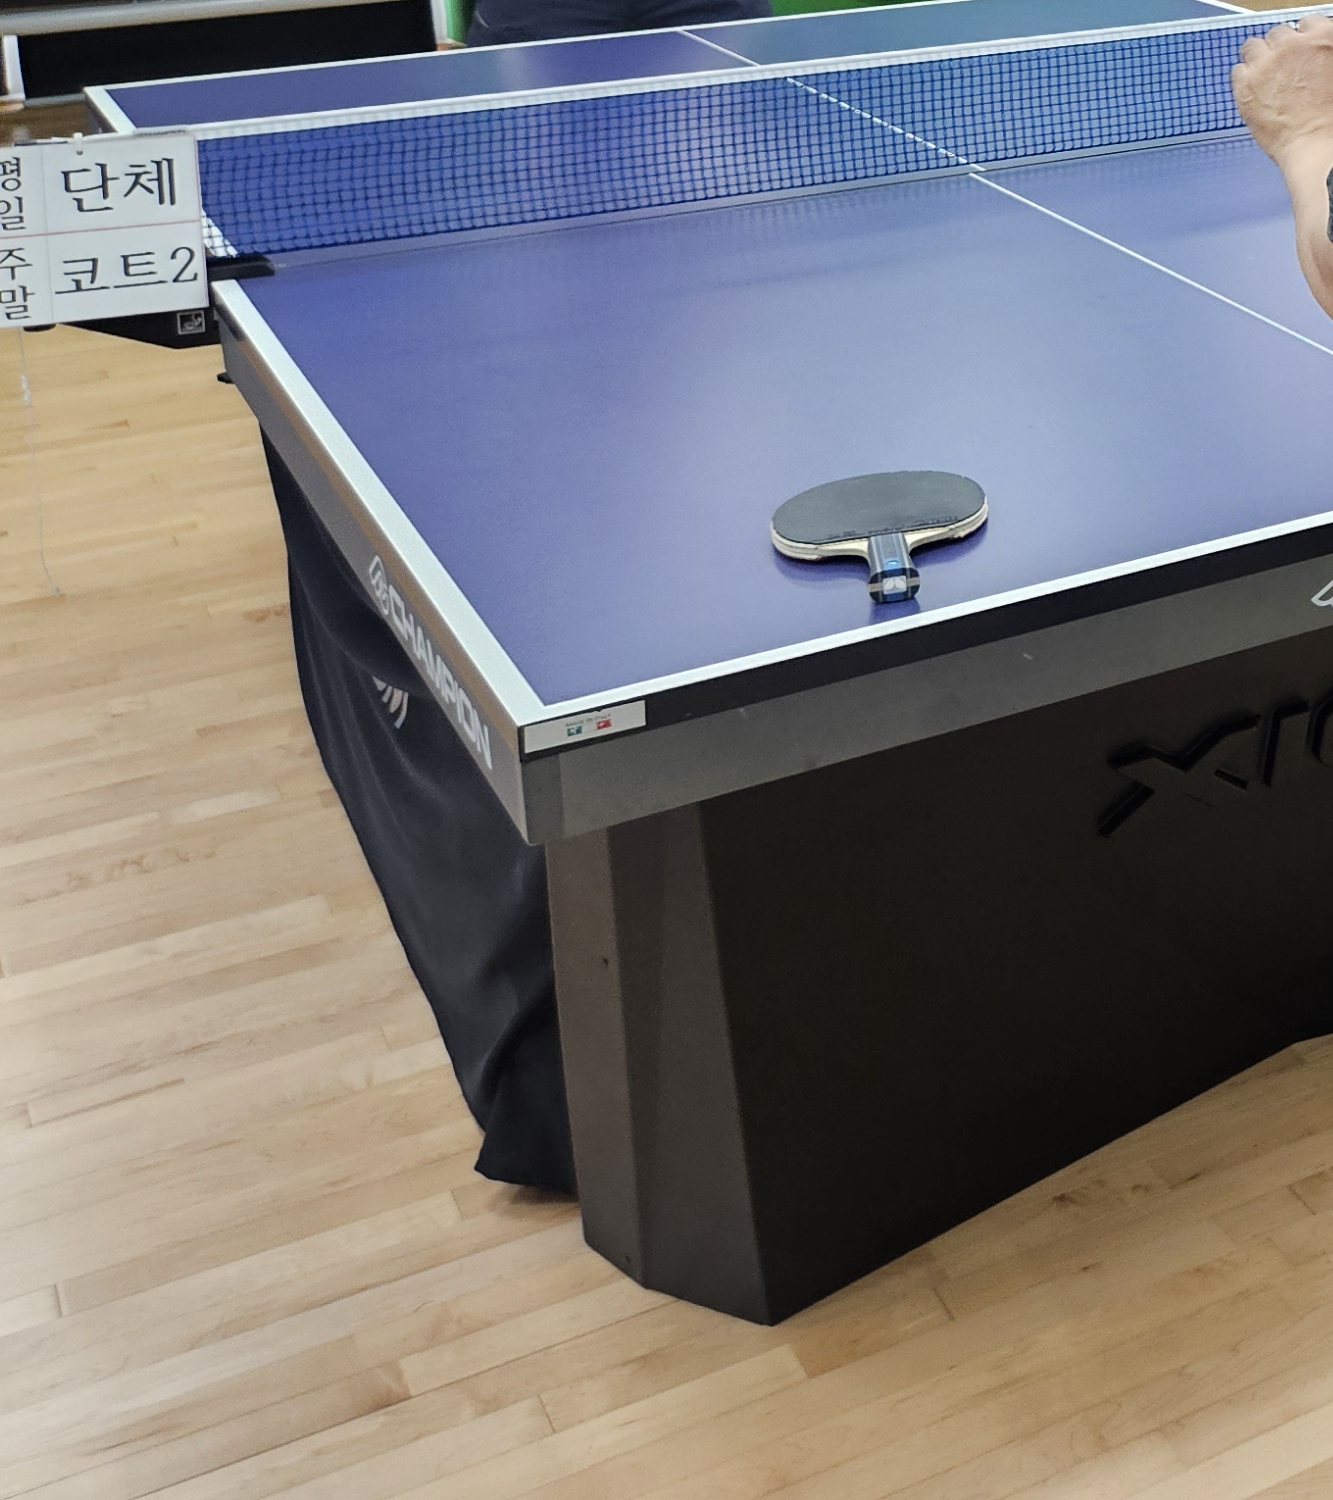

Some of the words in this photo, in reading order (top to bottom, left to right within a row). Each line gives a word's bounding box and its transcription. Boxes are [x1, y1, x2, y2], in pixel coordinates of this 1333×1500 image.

[61, 157, 177, 213] 단체
[0, 247, 35, 321] 주말
[55, 246, 199, 295] 코트2
[389, 587, 493, 771] CHAMPION
